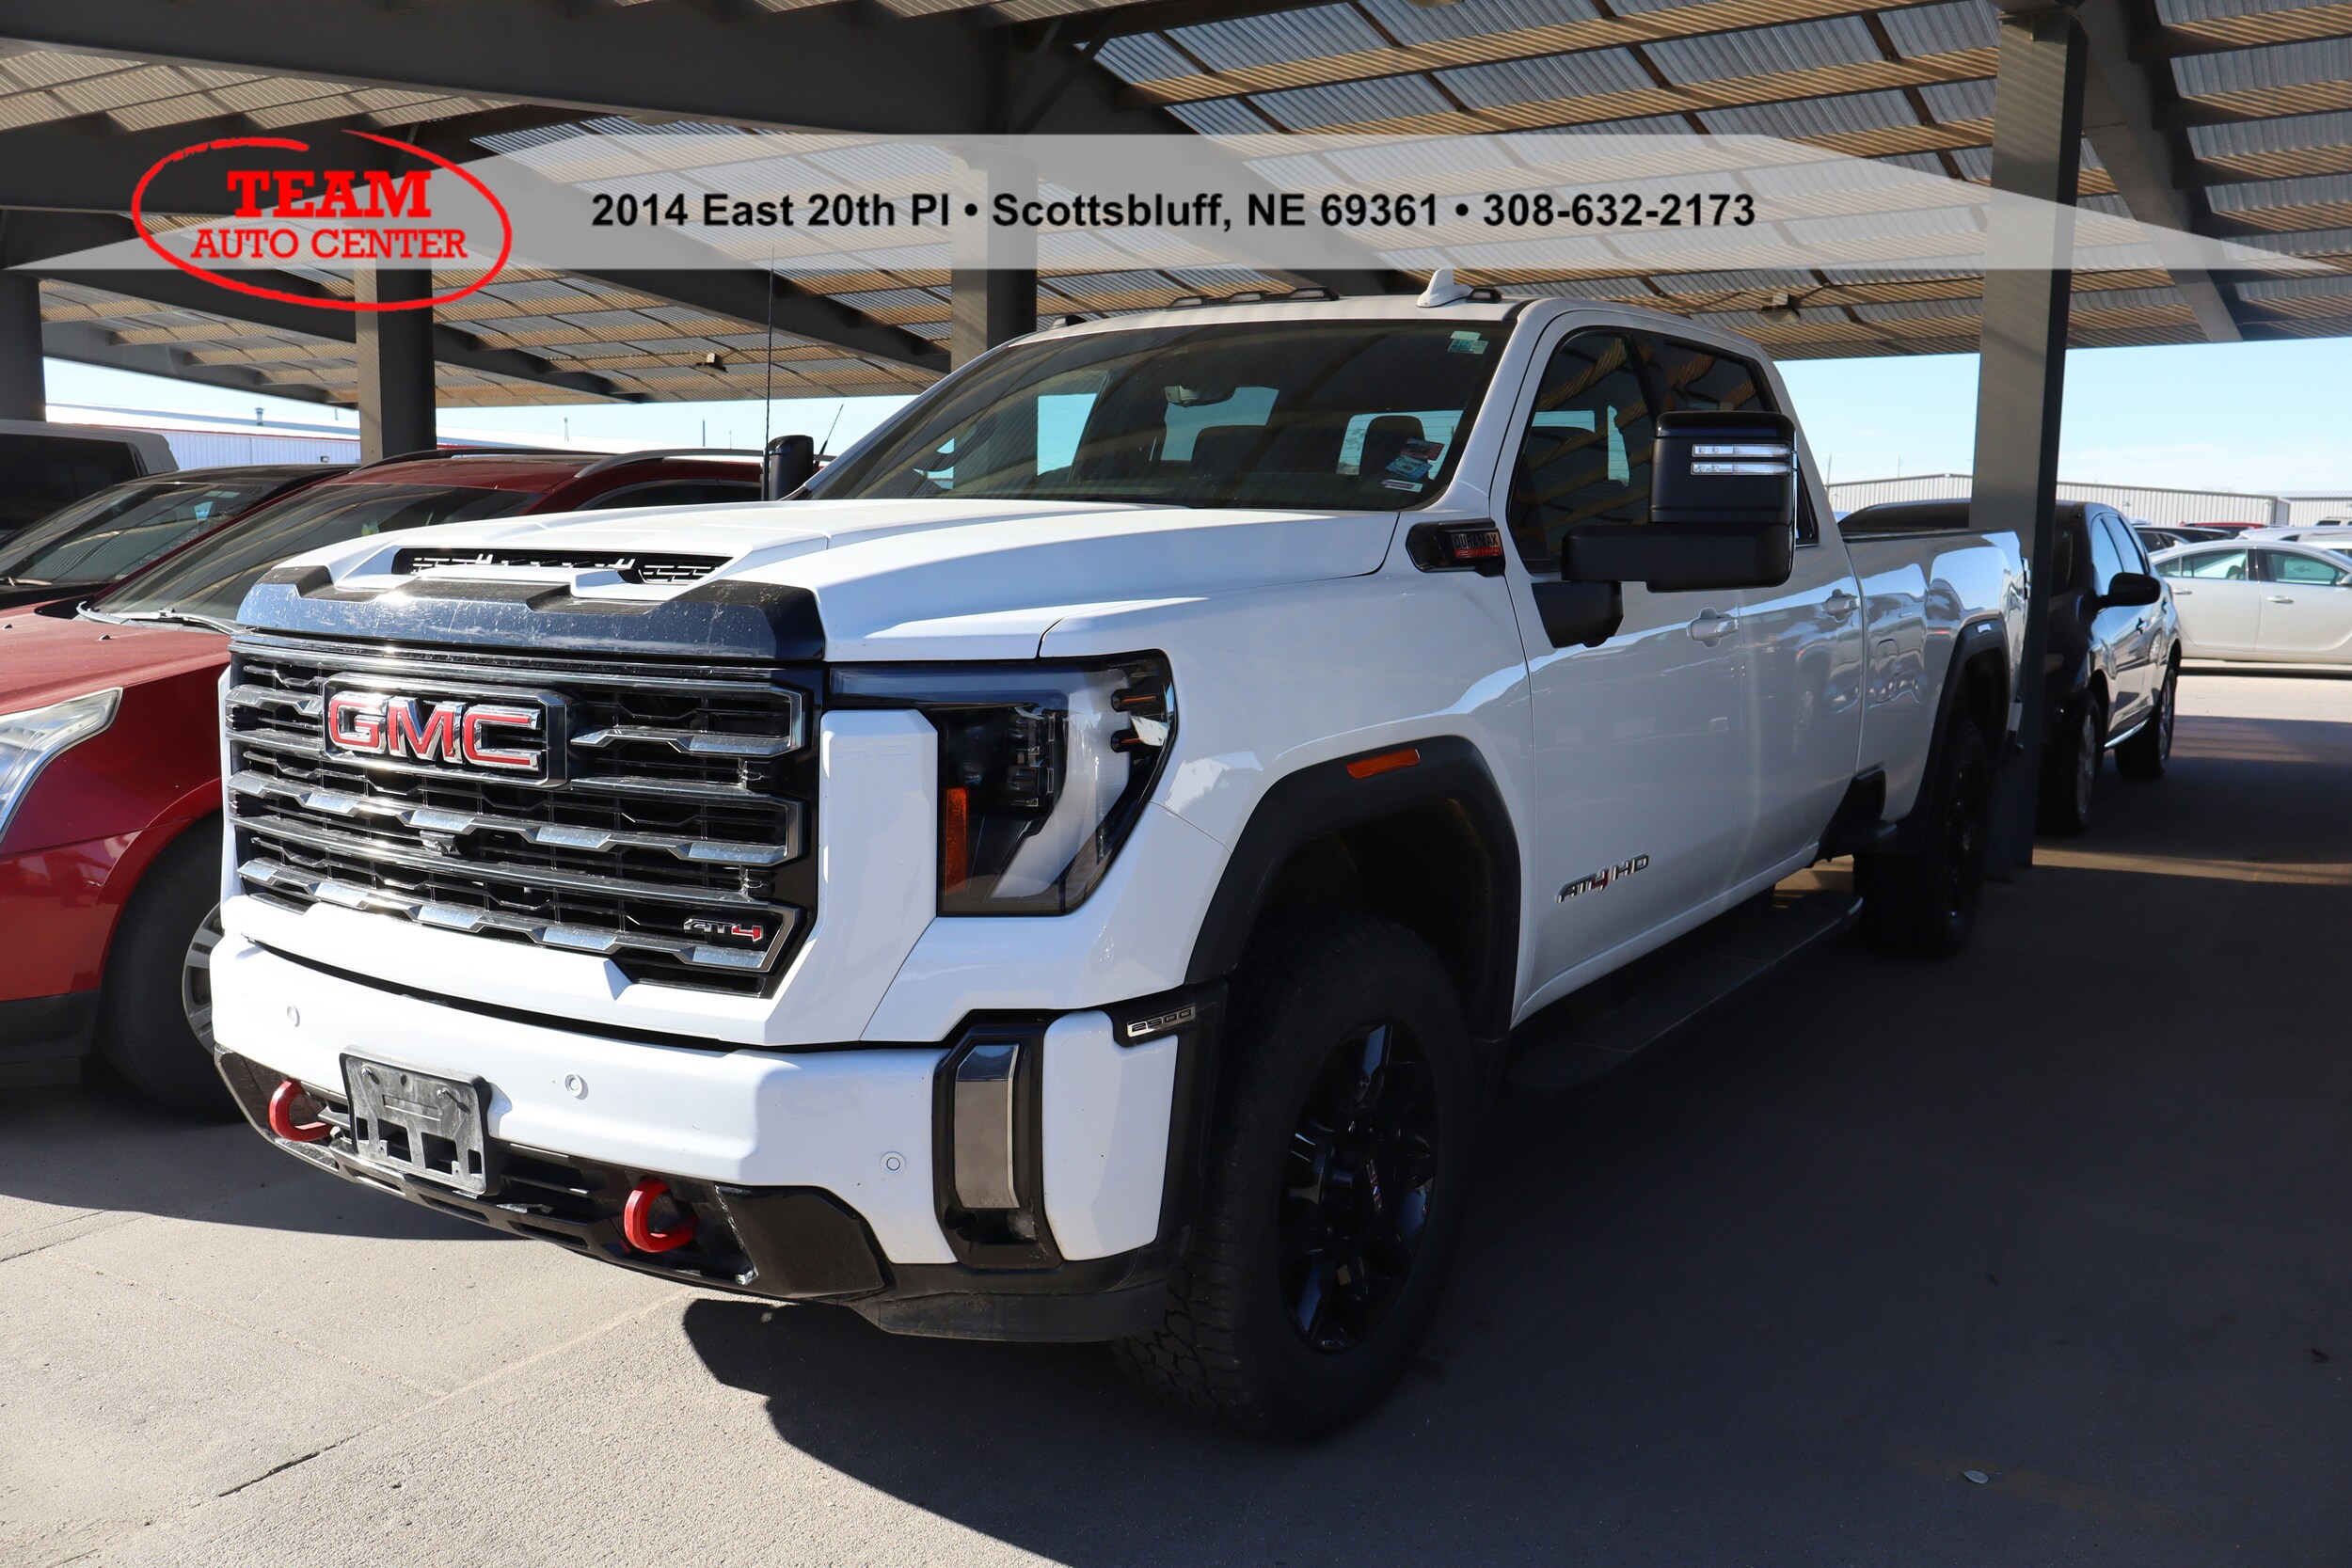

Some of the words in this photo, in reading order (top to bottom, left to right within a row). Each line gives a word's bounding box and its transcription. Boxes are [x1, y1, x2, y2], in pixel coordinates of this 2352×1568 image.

[1454, 532, 1499, 548] DURAMAX
[328, 690, 541, 771] GMC
[1554, 869, 1610, 904] AT4
[1609, 853, 1649, 881] HD
[683, 918, 764, 942] AT4
[1127, 1006, 1195, 1037] 2500
